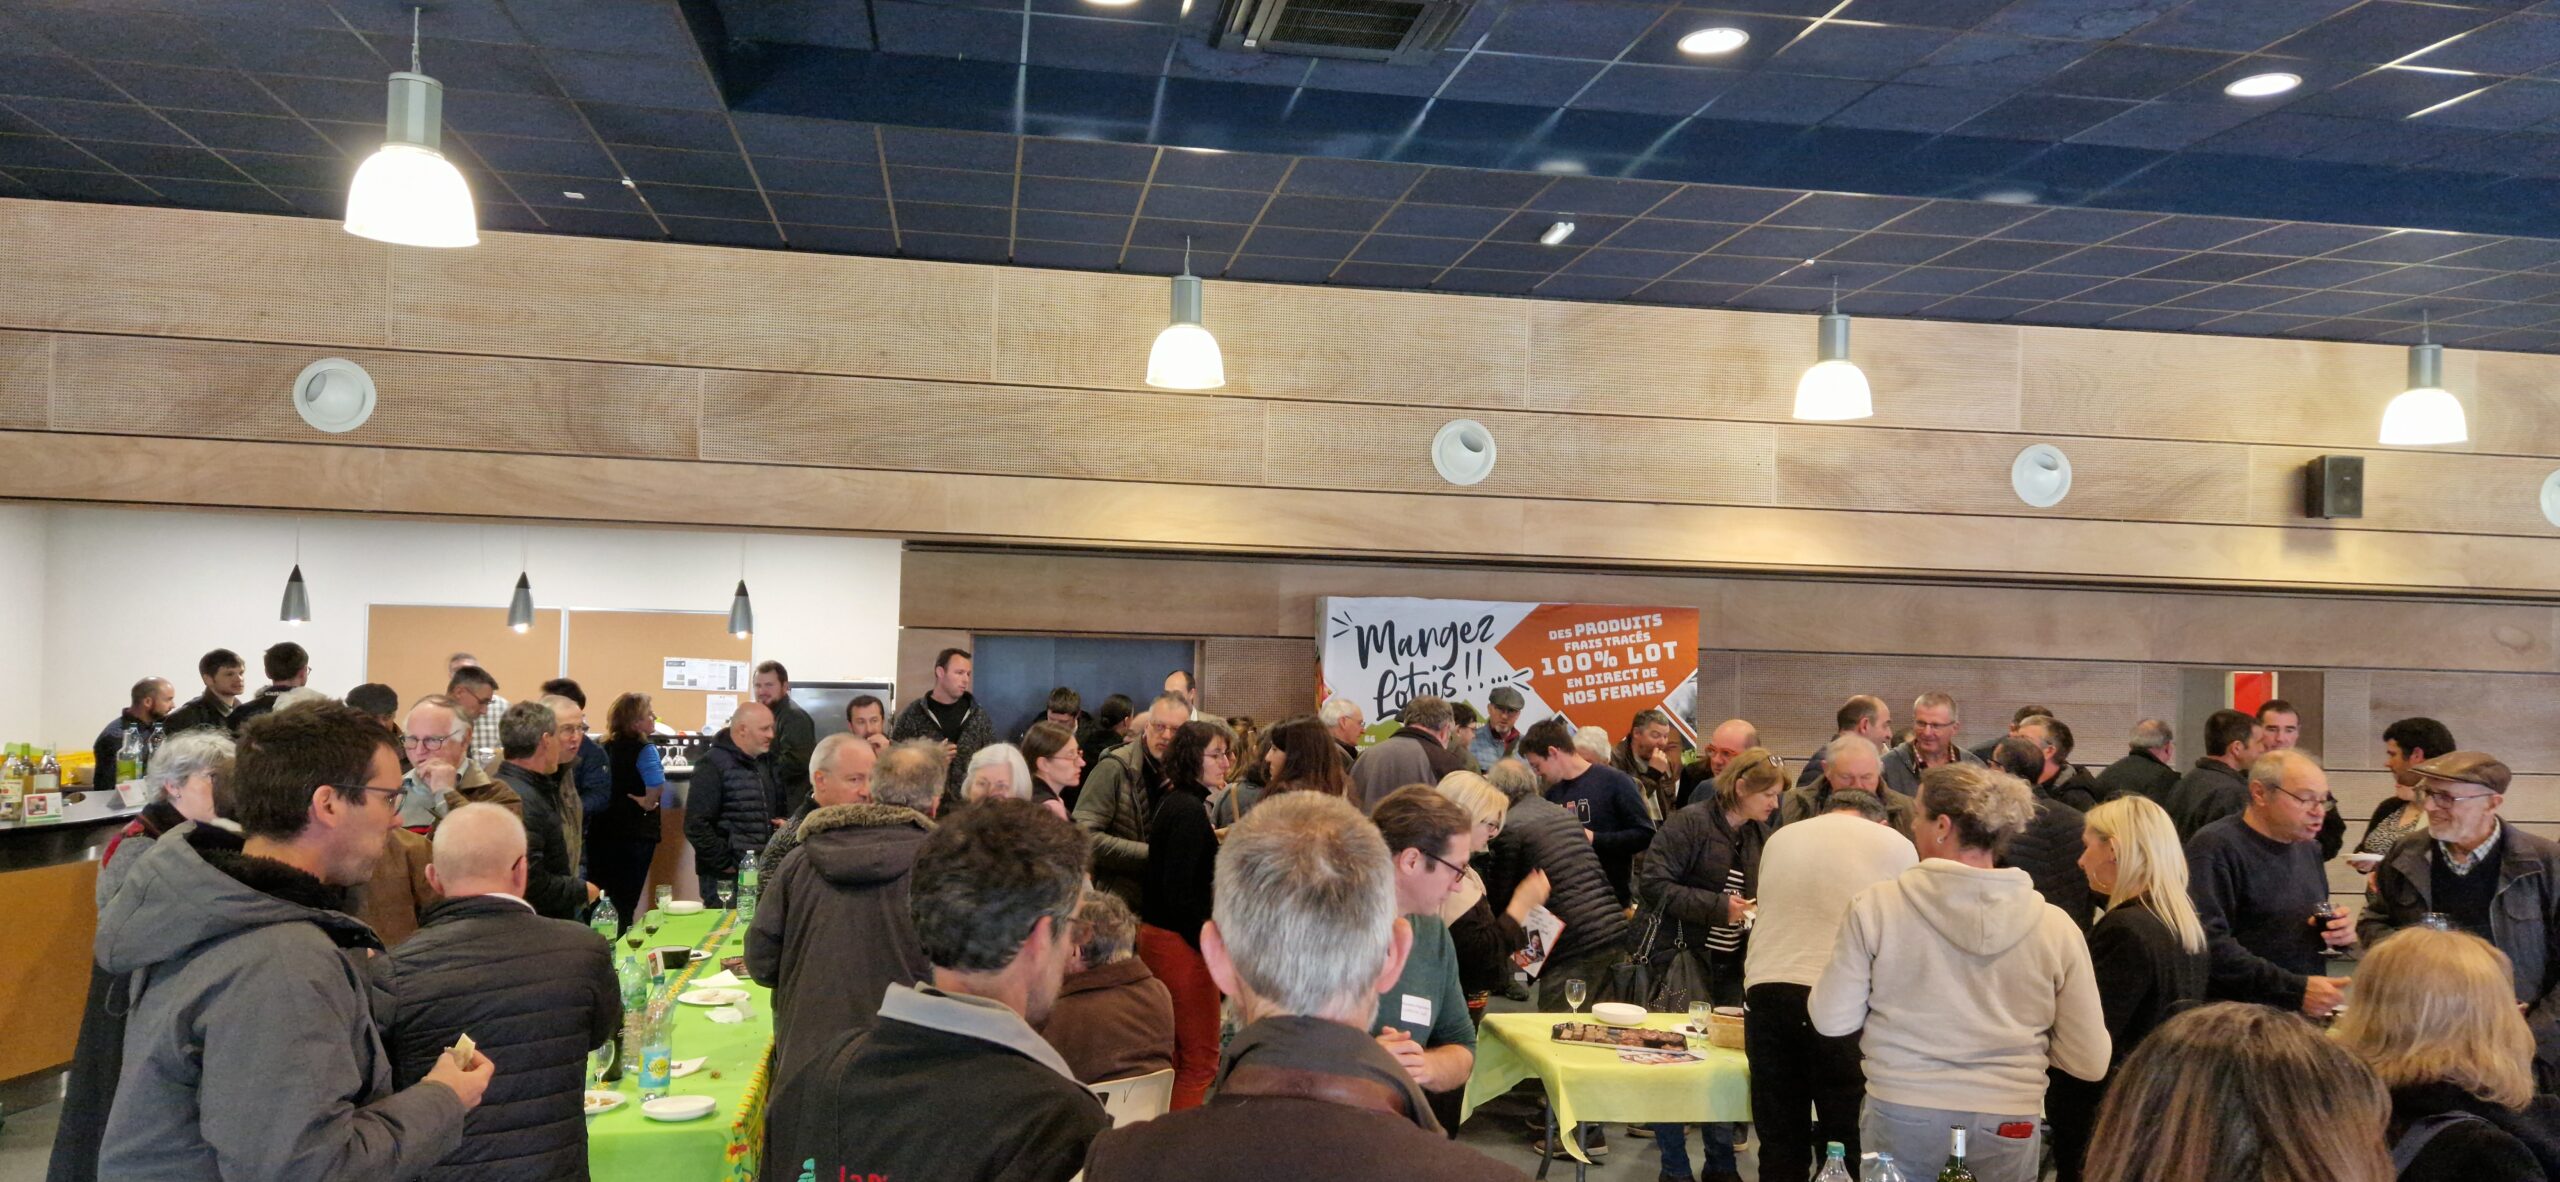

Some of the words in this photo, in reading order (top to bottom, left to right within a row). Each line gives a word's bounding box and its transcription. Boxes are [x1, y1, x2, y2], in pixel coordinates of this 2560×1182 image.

[1549, 629, 1572, 640] DES
[1574, 613, 1663, 637] PRODUITS
[1355, 614, 1495, 671] Mangez
[1564, 638, 1603, 652] FRAIS
[1604, 631, 1651, 647] TRACÉS
[1541, 650, 1618, 676] 100%
[1627, 641, 1678, 665] LOT
[1566, 677, 1583, 688] EN
[1585, 668, 1639, 686] DIRECT
[1641, 667, 1658, 679] DE
[1562, 689, 1597, 705] NOS
[1600, 680, 1666, 701] FERMES
